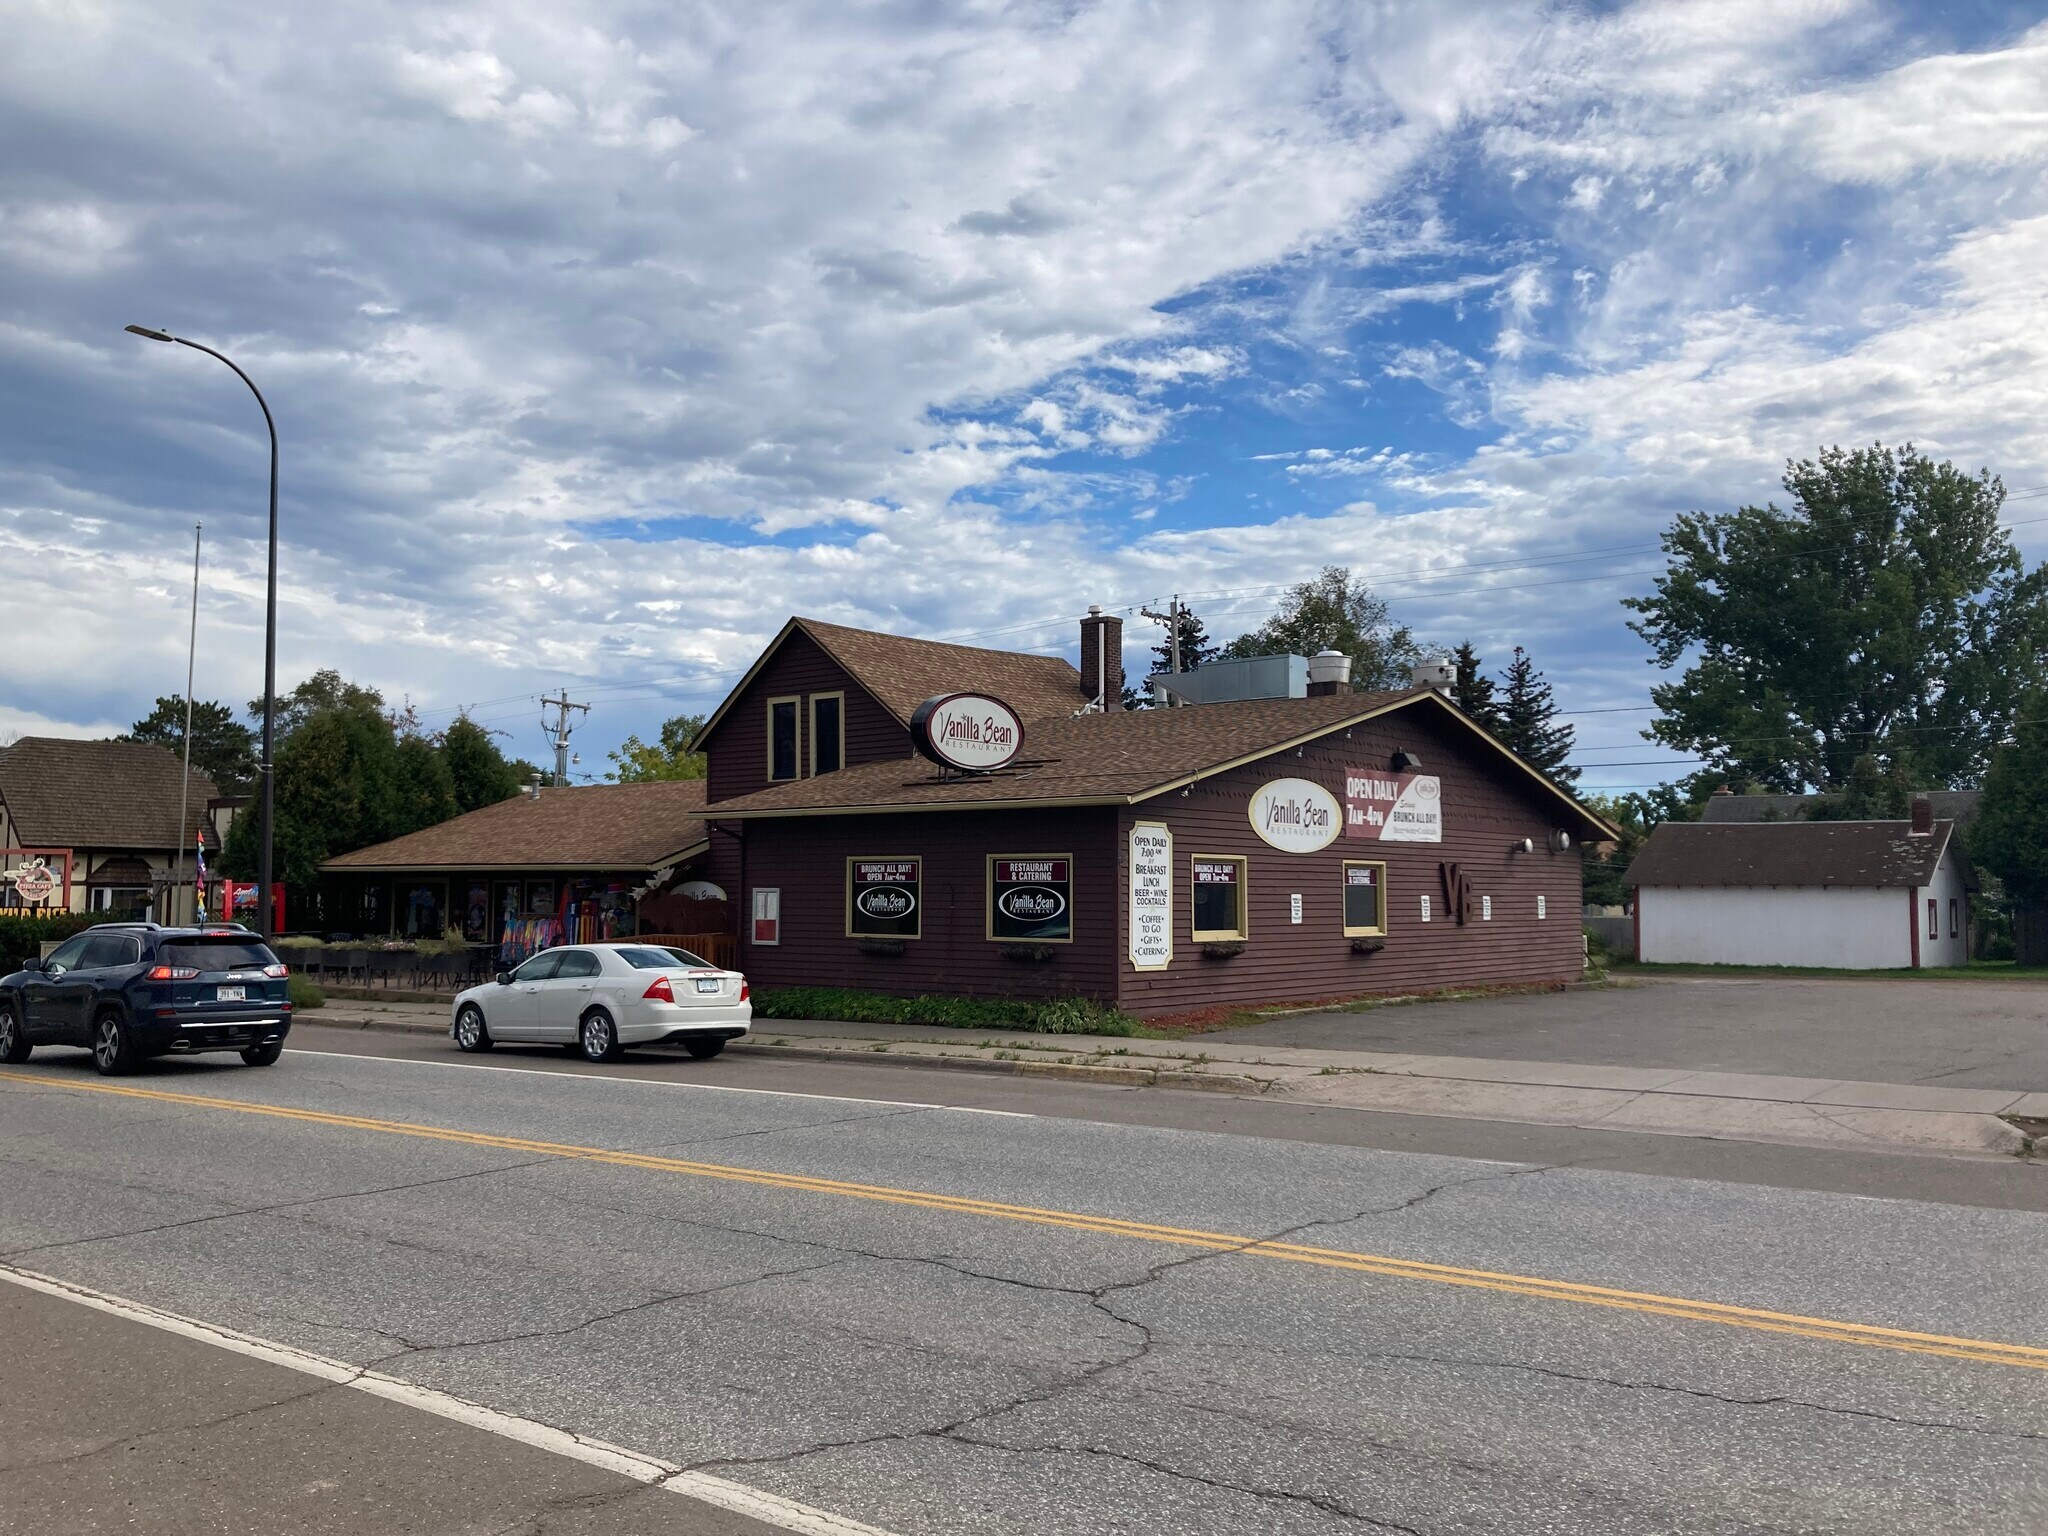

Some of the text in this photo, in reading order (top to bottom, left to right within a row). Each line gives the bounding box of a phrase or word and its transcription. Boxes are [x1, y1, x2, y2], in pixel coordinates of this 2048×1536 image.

[940, 711, 1012, 744] Vanilla Bean
[945, 739, 1012, 752] RESTAURANT
[1347, 777, 1373, 799] OPEN
[1373, 779, 1399, 801] DAILY
[1265, 796, 1328, 830] Vanilla Bean
[1347, 803, 1384, 826] 7AM-4PM
[1416, 812, 1426, 824] ALL
[1270, 826, 1328, 837] RESTAURANT
[1134, 835, 1167, 848] OPEN DAILY
[1140, 847, 1155, 858] 7:00
[861, 864, 912, 873] BRUNCH ALL DAY!
[1009, 862, 1053, 872] RESTAURANT
[1135, 863, 1167, 875] BREAKFAST
[866, 872, 882, 881] OPEN
[1011, 871, 1052, 881] & CATERING
[1142, 876, 1160, 887] LUNCH
[1134, 888, 1168, 897] BEER WINE
[866, 893, 906, 910] Vanilla Bean
[1009, 893, 1054, 911] Vanilla Bean
[1136, 897, 1166, 906] COCKTAILS
[1142, 924, 1161, 933] TO GO
